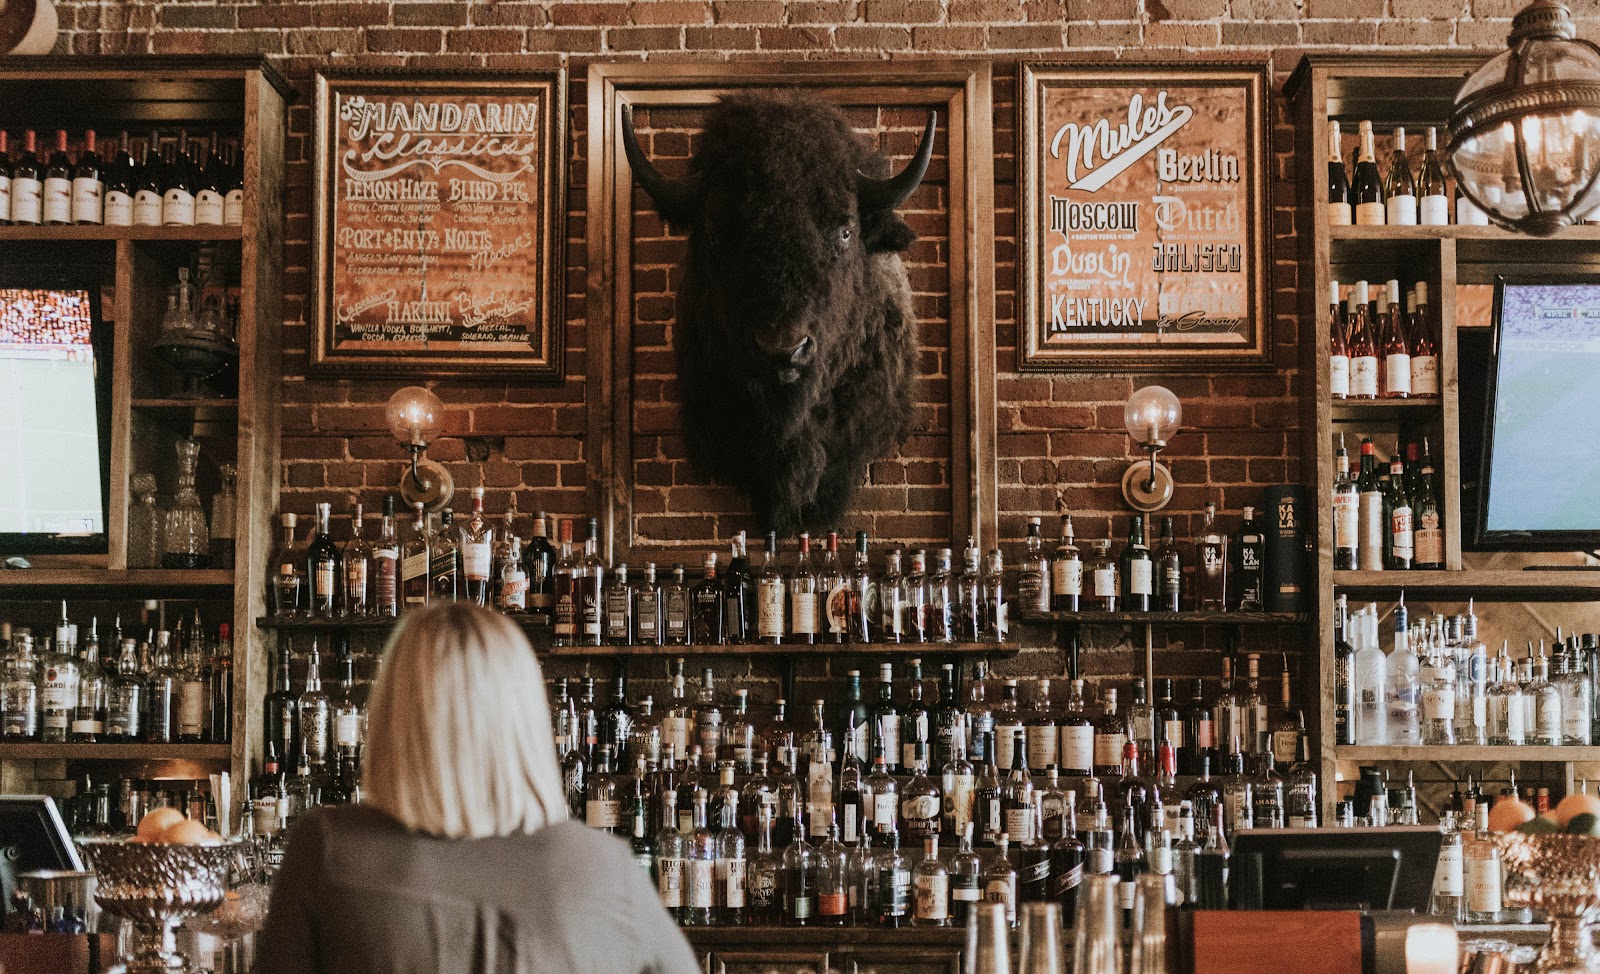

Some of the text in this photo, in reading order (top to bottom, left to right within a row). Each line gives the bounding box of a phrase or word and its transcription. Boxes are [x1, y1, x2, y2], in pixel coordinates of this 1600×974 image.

[350, 102, 537, 141] MANDARIN
[362, 132, 535, 162] Classics
[1050, 90, 1188, 188] Mules
[1158, 149, 1240, 184] Berlin
[345, 179, 439, 201] LEMON HAZE
[449, 178, 530, 202] BLIND PIG
[1152, 193, 1239, 233] Dutch
[393, 228, 436, 251] ENVY
[1153, 243, 1241, 273] JALISCO
[387, 301, 452, 322] MARTINI
[1051, 294, 1146, 331] KENTUCKY
[1177, 311, 1243, 333] Stormy
[351, 323, 380, 333] VANILLA
